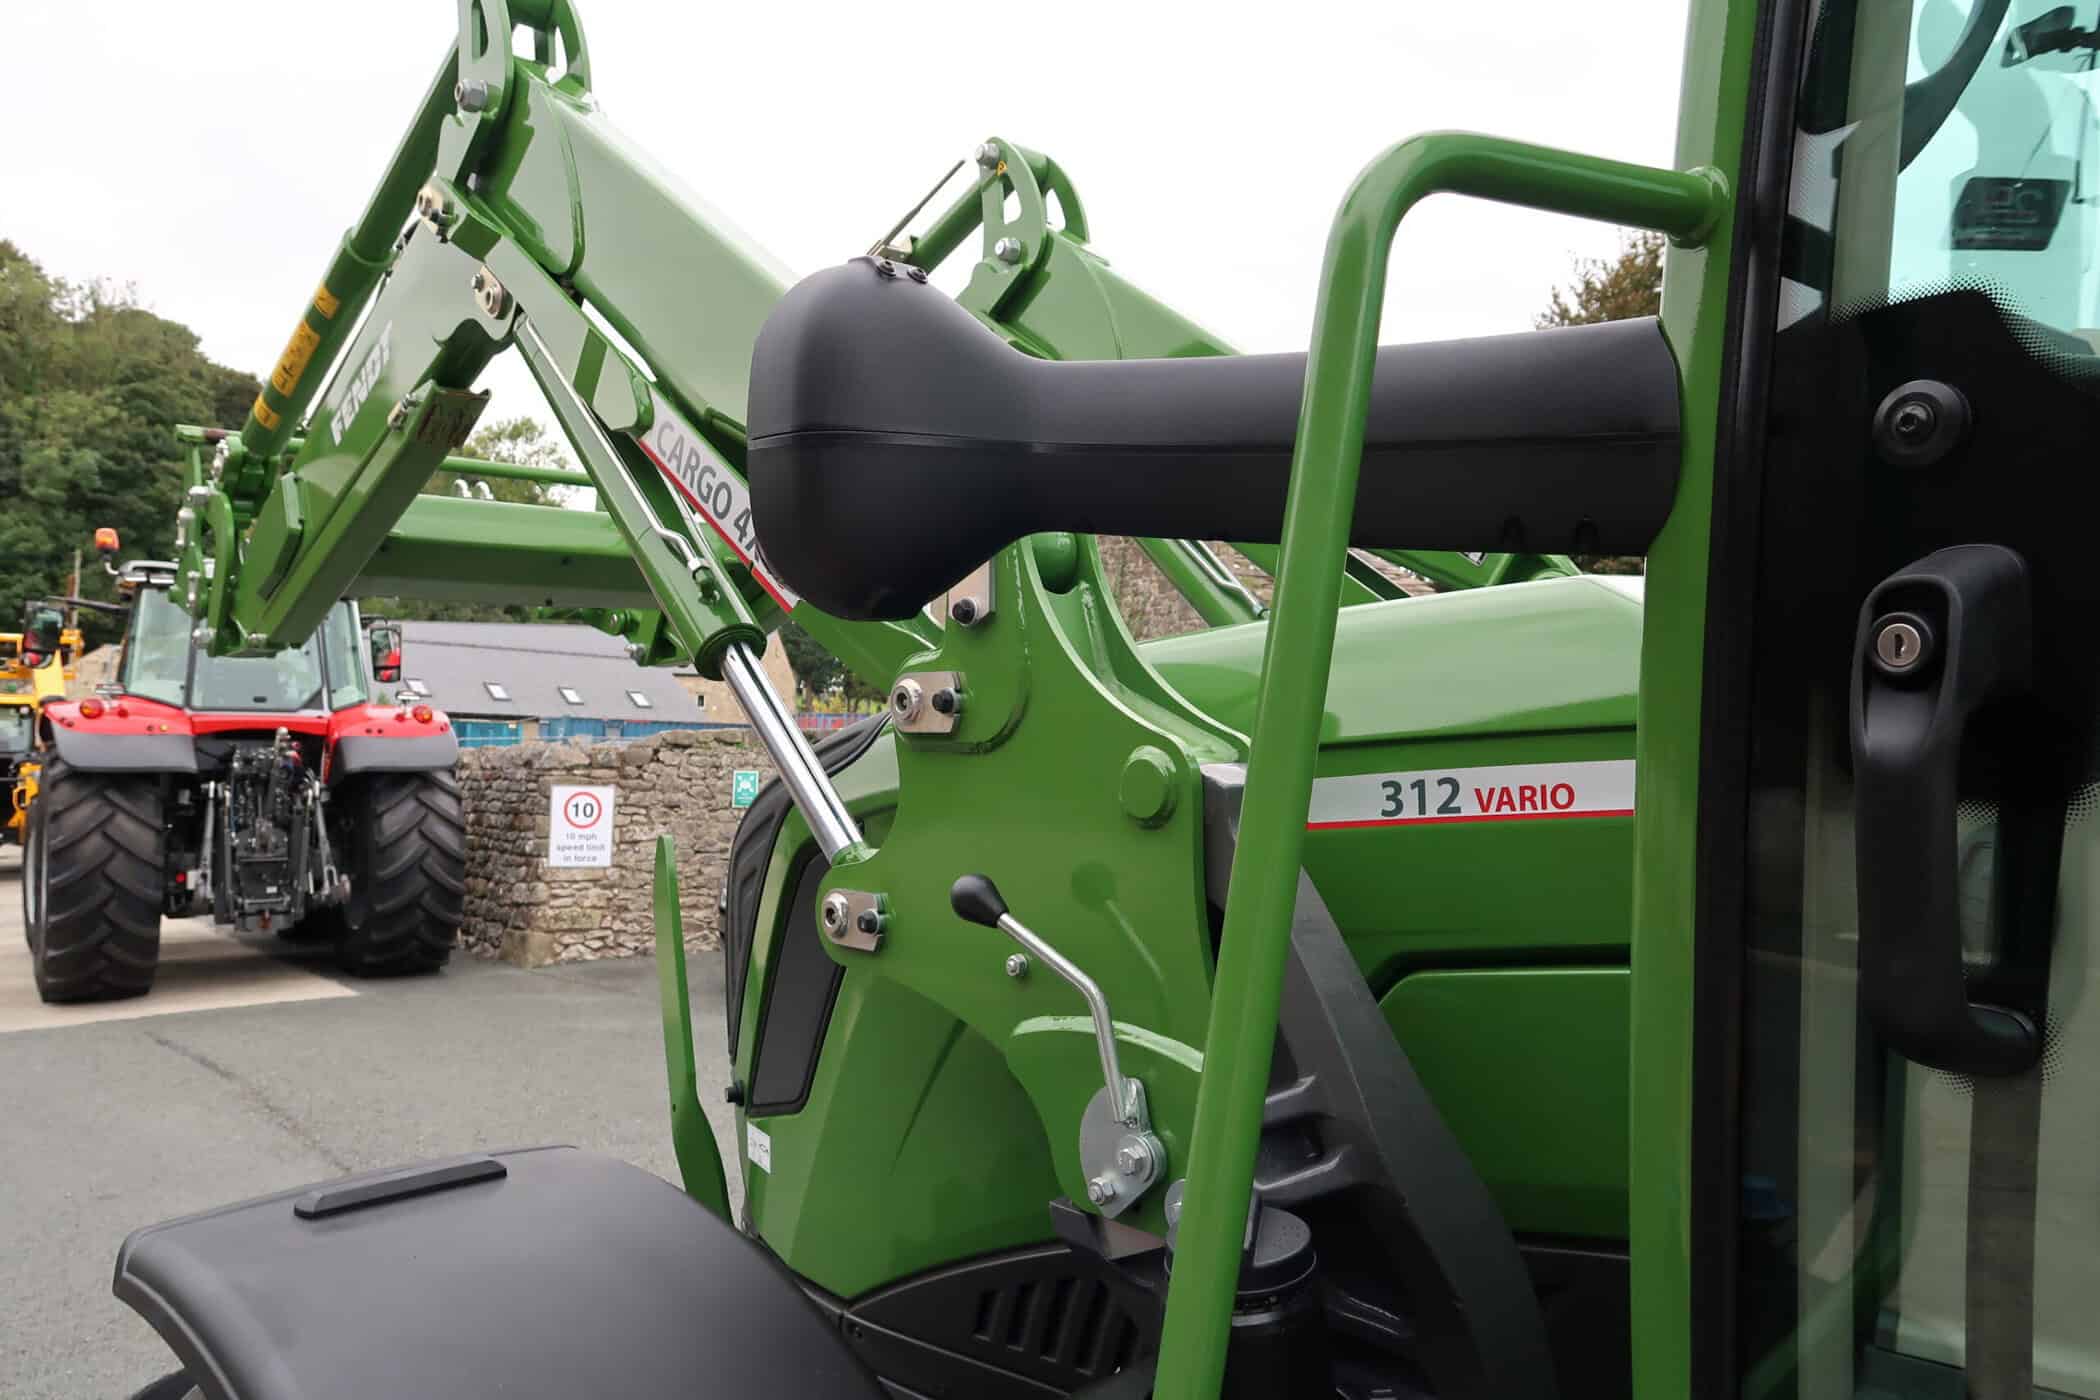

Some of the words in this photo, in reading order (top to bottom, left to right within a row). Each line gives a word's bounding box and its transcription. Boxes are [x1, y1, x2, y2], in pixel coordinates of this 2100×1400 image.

[656, 421, 733, 520] CARGO
[1380, 776, 1462, 818] 312
[1474, 782, 1576, 814] VARIO
[572, 802, 595, 818] 10
[566, 832, 576, 841] 10
[577, 832, 598, 842] mph
[556, 843, 585, 853] speed
[586, 843, 606, 852] limit
[563, 854, 572, 862] in
[574, 854, 598, 862] force
